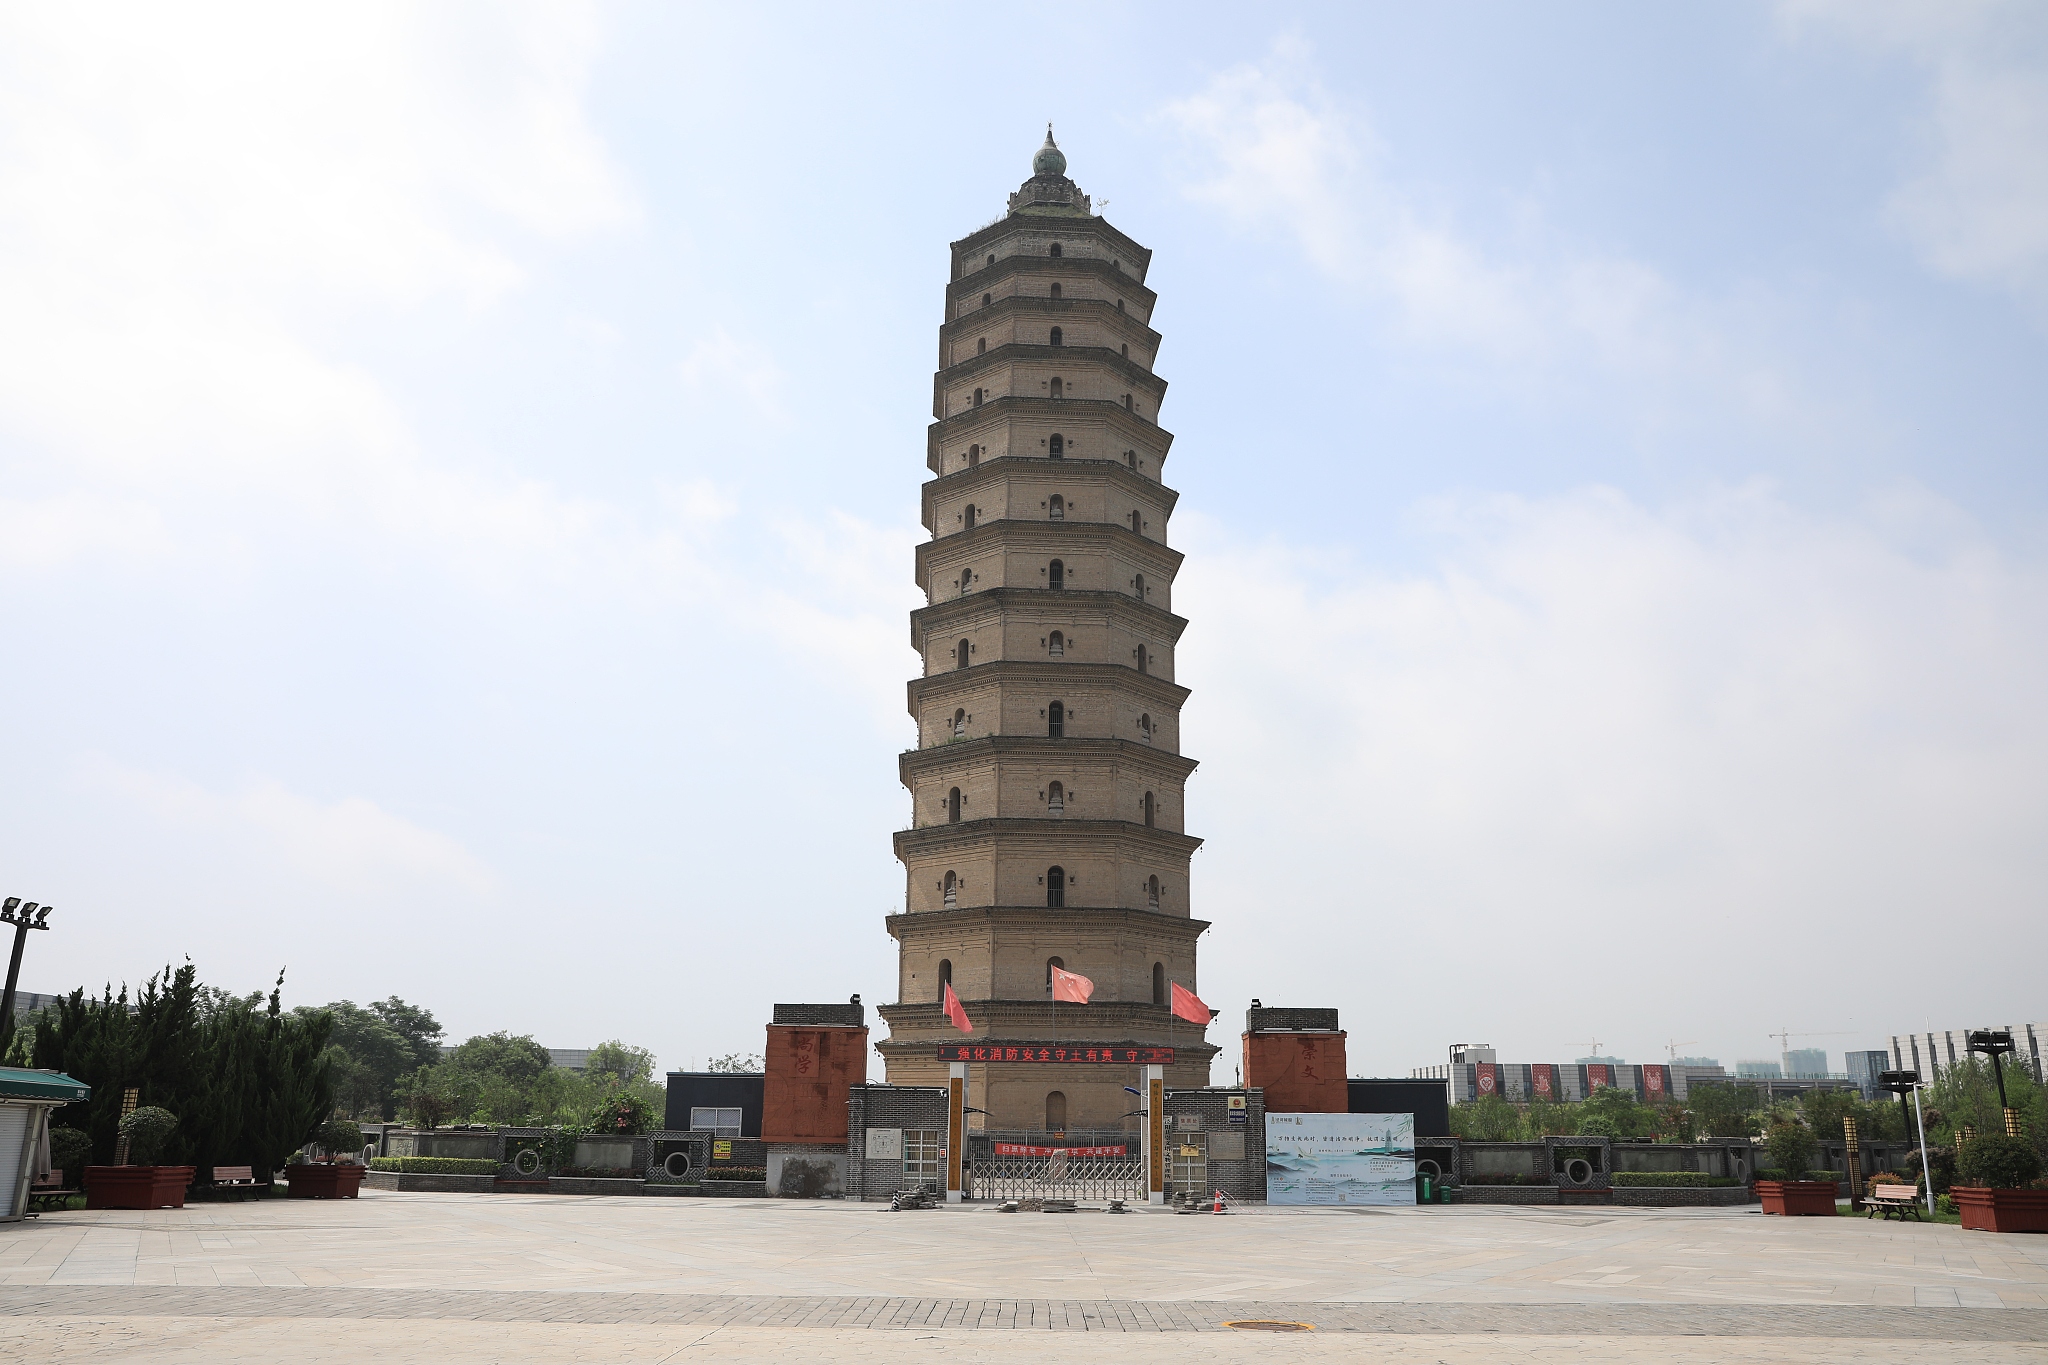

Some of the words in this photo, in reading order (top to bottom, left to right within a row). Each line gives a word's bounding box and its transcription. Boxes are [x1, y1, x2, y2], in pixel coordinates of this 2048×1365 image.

[794, 1036, 813, 1074] 尚学
[957, 1047, 1113, 1063] 强化消防安全守土有责
[1300, 1043, 1319, 1080] 崇文
